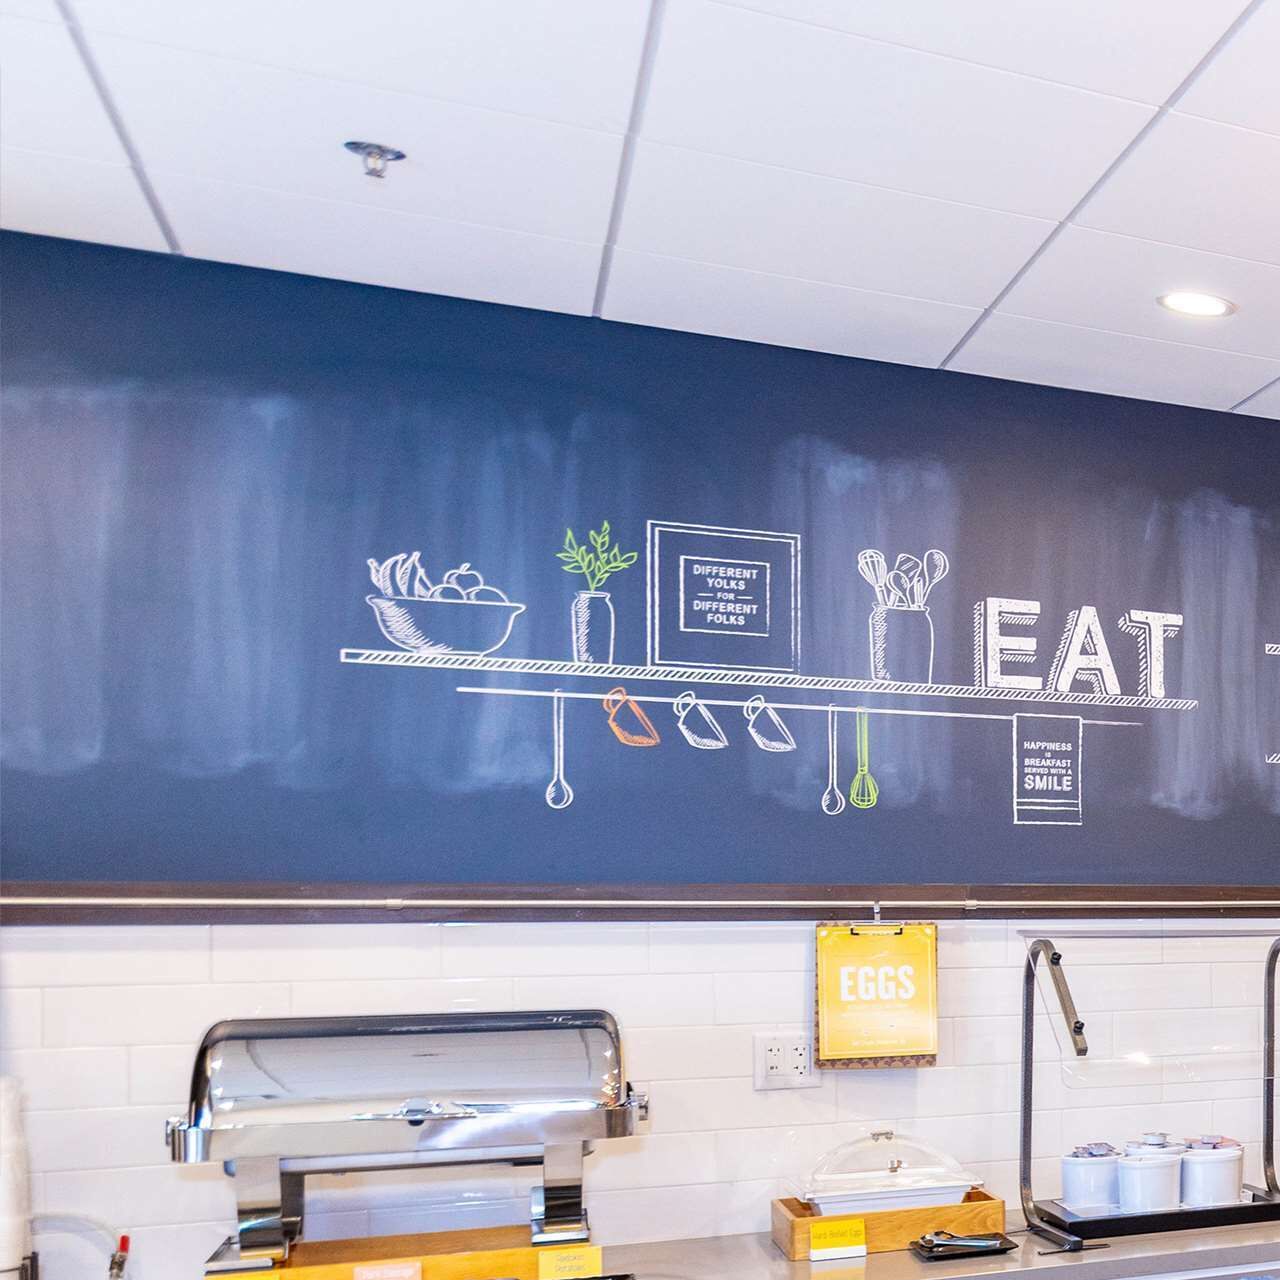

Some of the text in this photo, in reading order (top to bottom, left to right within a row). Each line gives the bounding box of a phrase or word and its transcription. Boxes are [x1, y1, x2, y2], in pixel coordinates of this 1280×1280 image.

[693, 564, 759, 579] DIFFERENT
[706, 578, 746, 590] YOLKS
[717, 592, 735, 600] FOR
[693, 600, 759, 615] DIFFERENT
[706, 613, 746, 626] FOLKS
[973, 597, 1183, 698] EAT
[1023, 741, 1073, 751] HAPPINESS
[1023, 758, 1072, 768] BREAKFAST
[1023, 775, 1073, 791] SMILE
[839, 964, 916, 1002] EGGS
